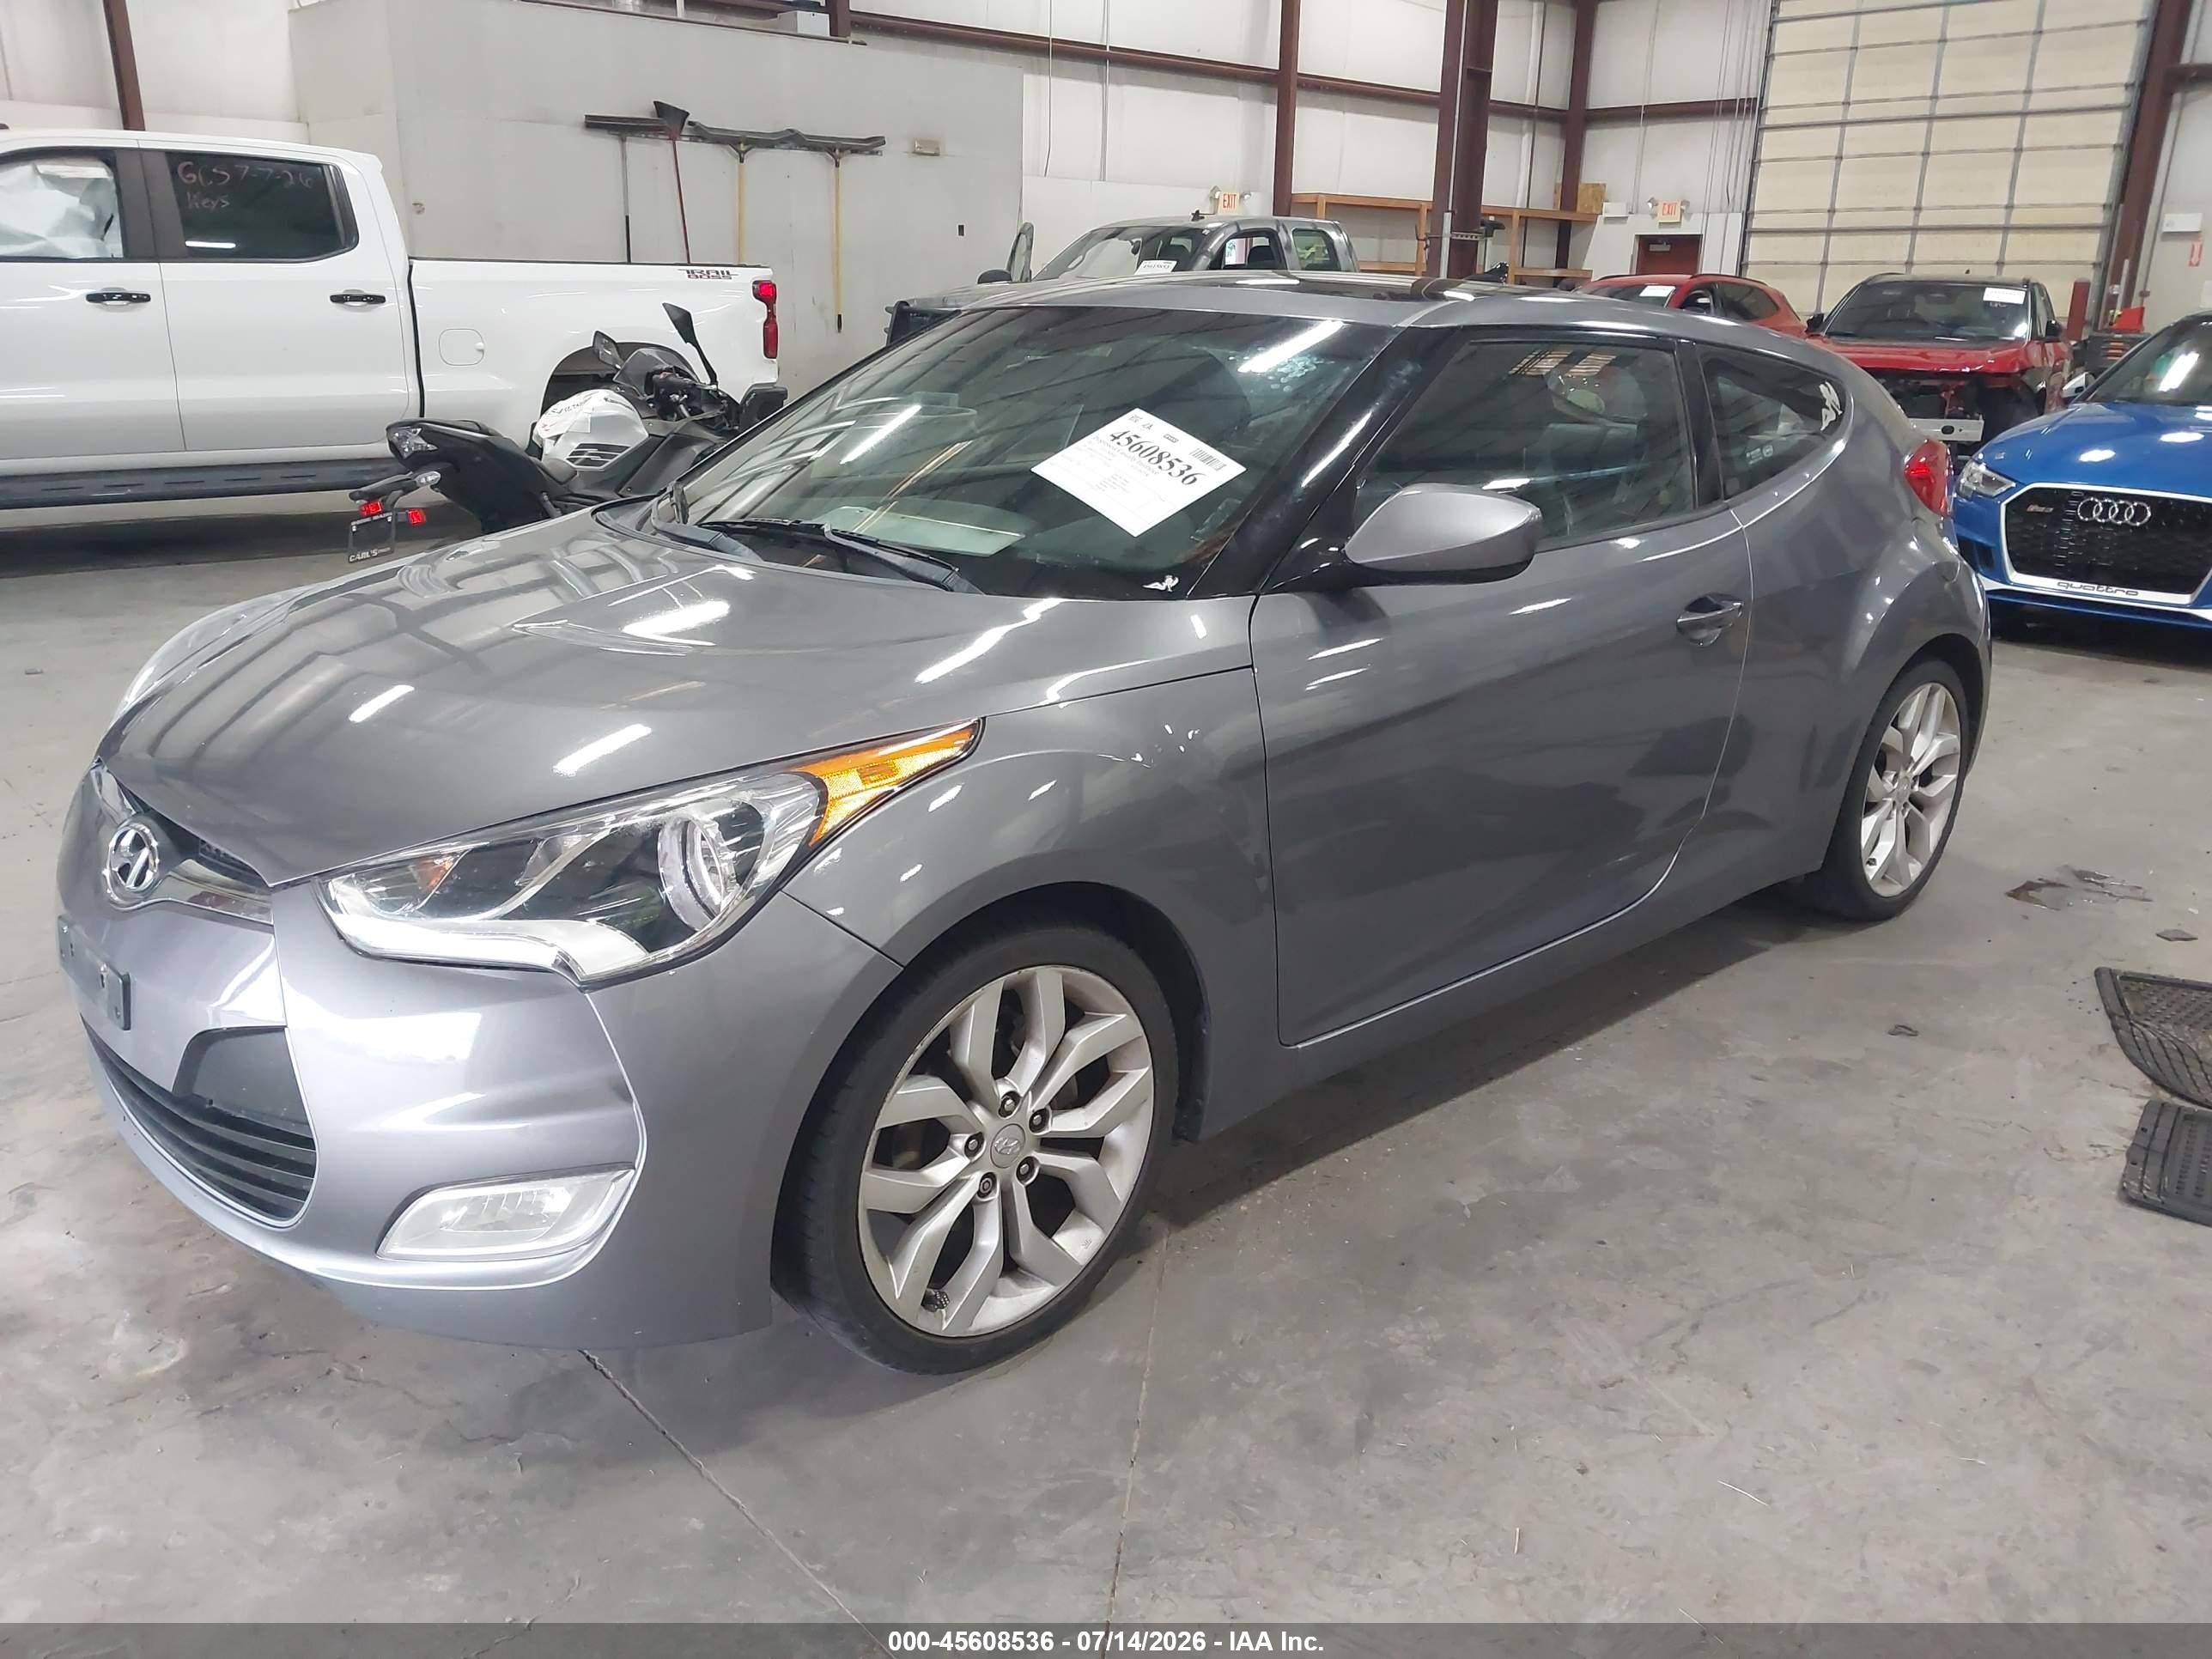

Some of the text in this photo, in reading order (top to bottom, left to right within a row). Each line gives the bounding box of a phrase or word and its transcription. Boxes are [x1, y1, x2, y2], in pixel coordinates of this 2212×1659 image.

[1222, 193, 1237, 209] EXIT
[678, 268, 739, 276] TRAIL
[1109, 429, 1206, 486] 45608536
[349, 550, 379, 562] CARL'S
[2057, 580, 2140, 597] quattro
